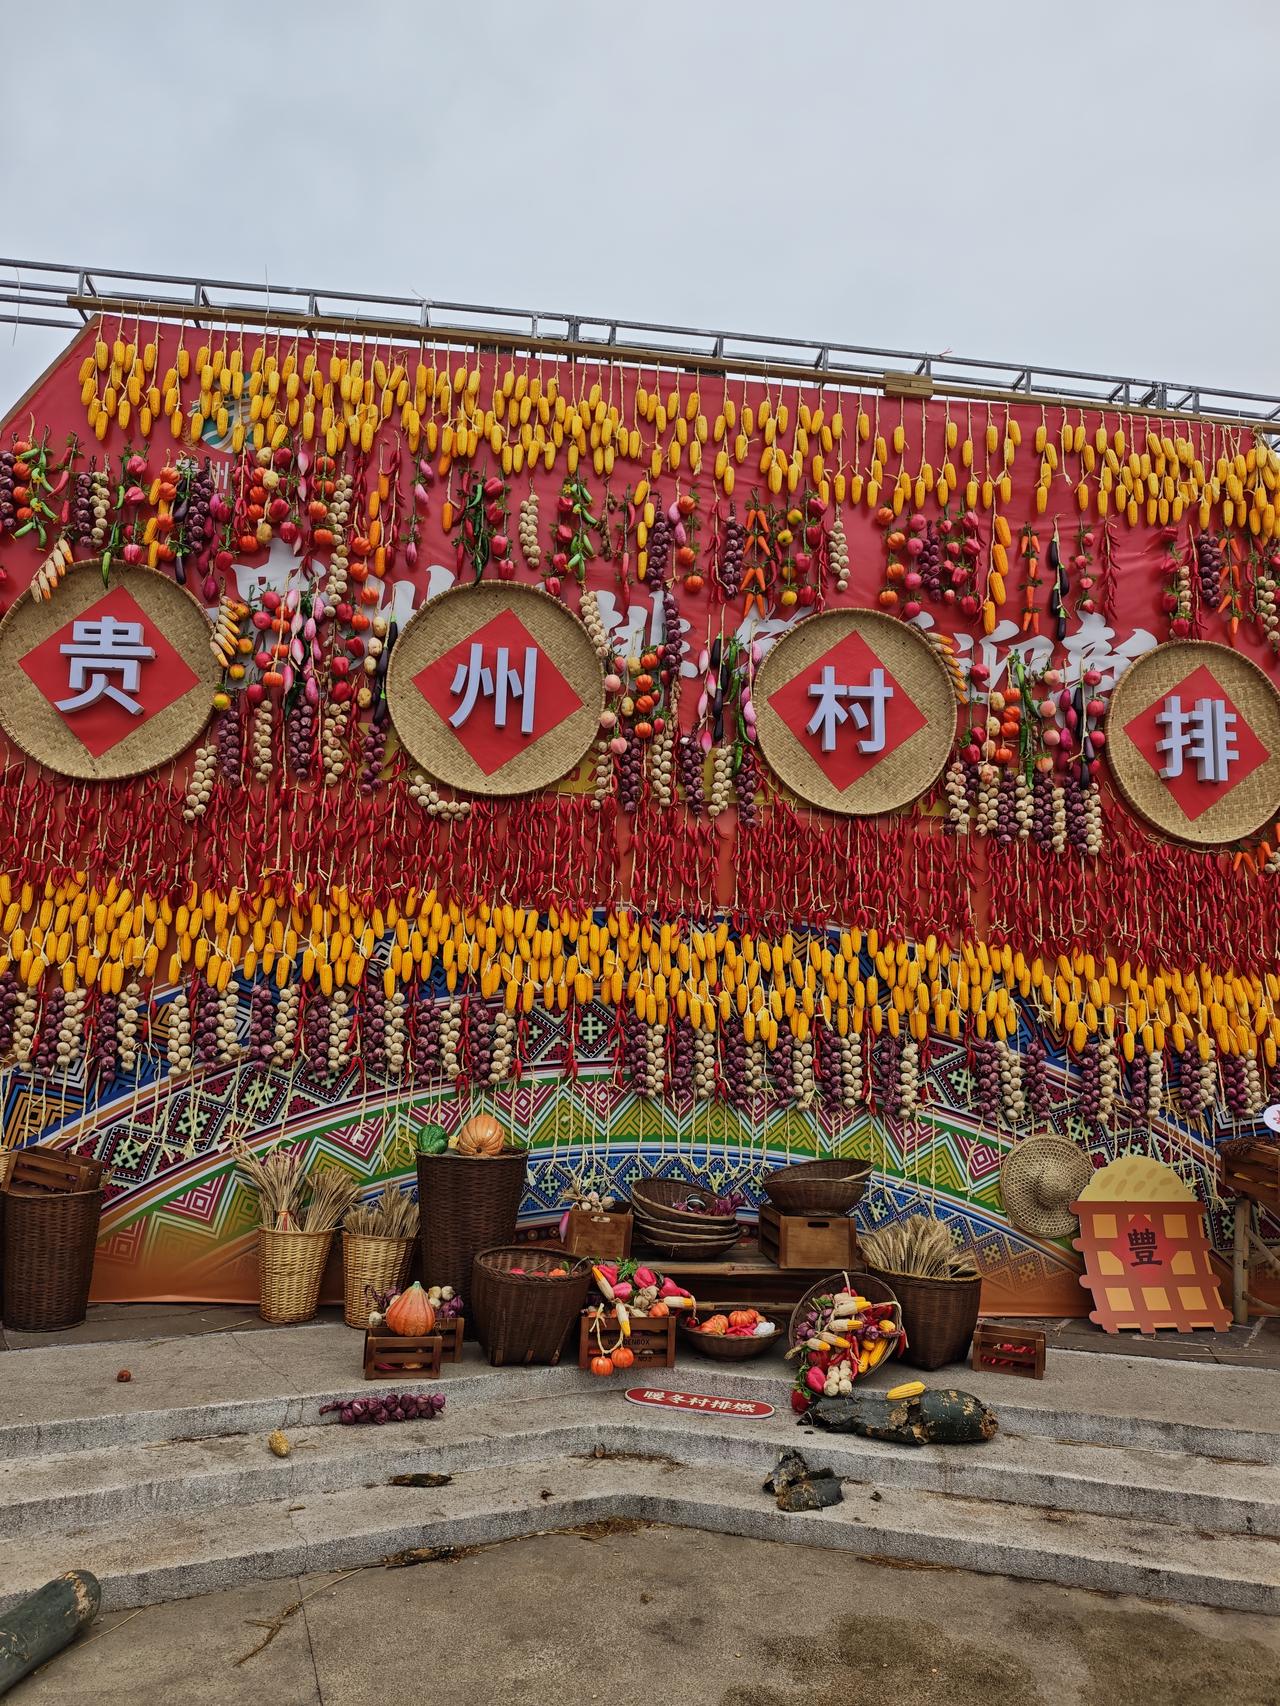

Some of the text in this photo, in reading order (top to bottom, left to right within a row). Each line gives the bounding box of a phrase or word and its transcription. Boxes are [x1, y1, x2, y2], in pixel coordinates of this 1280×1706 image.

[54, 615, 155, 716] 贵
[448, 643, 538, 735] 州
[807, 665, 894, 754] 村
[1155, 695, 1240, 782] 排
[643, 1390, 757, 1413] 暖冬村排燃
